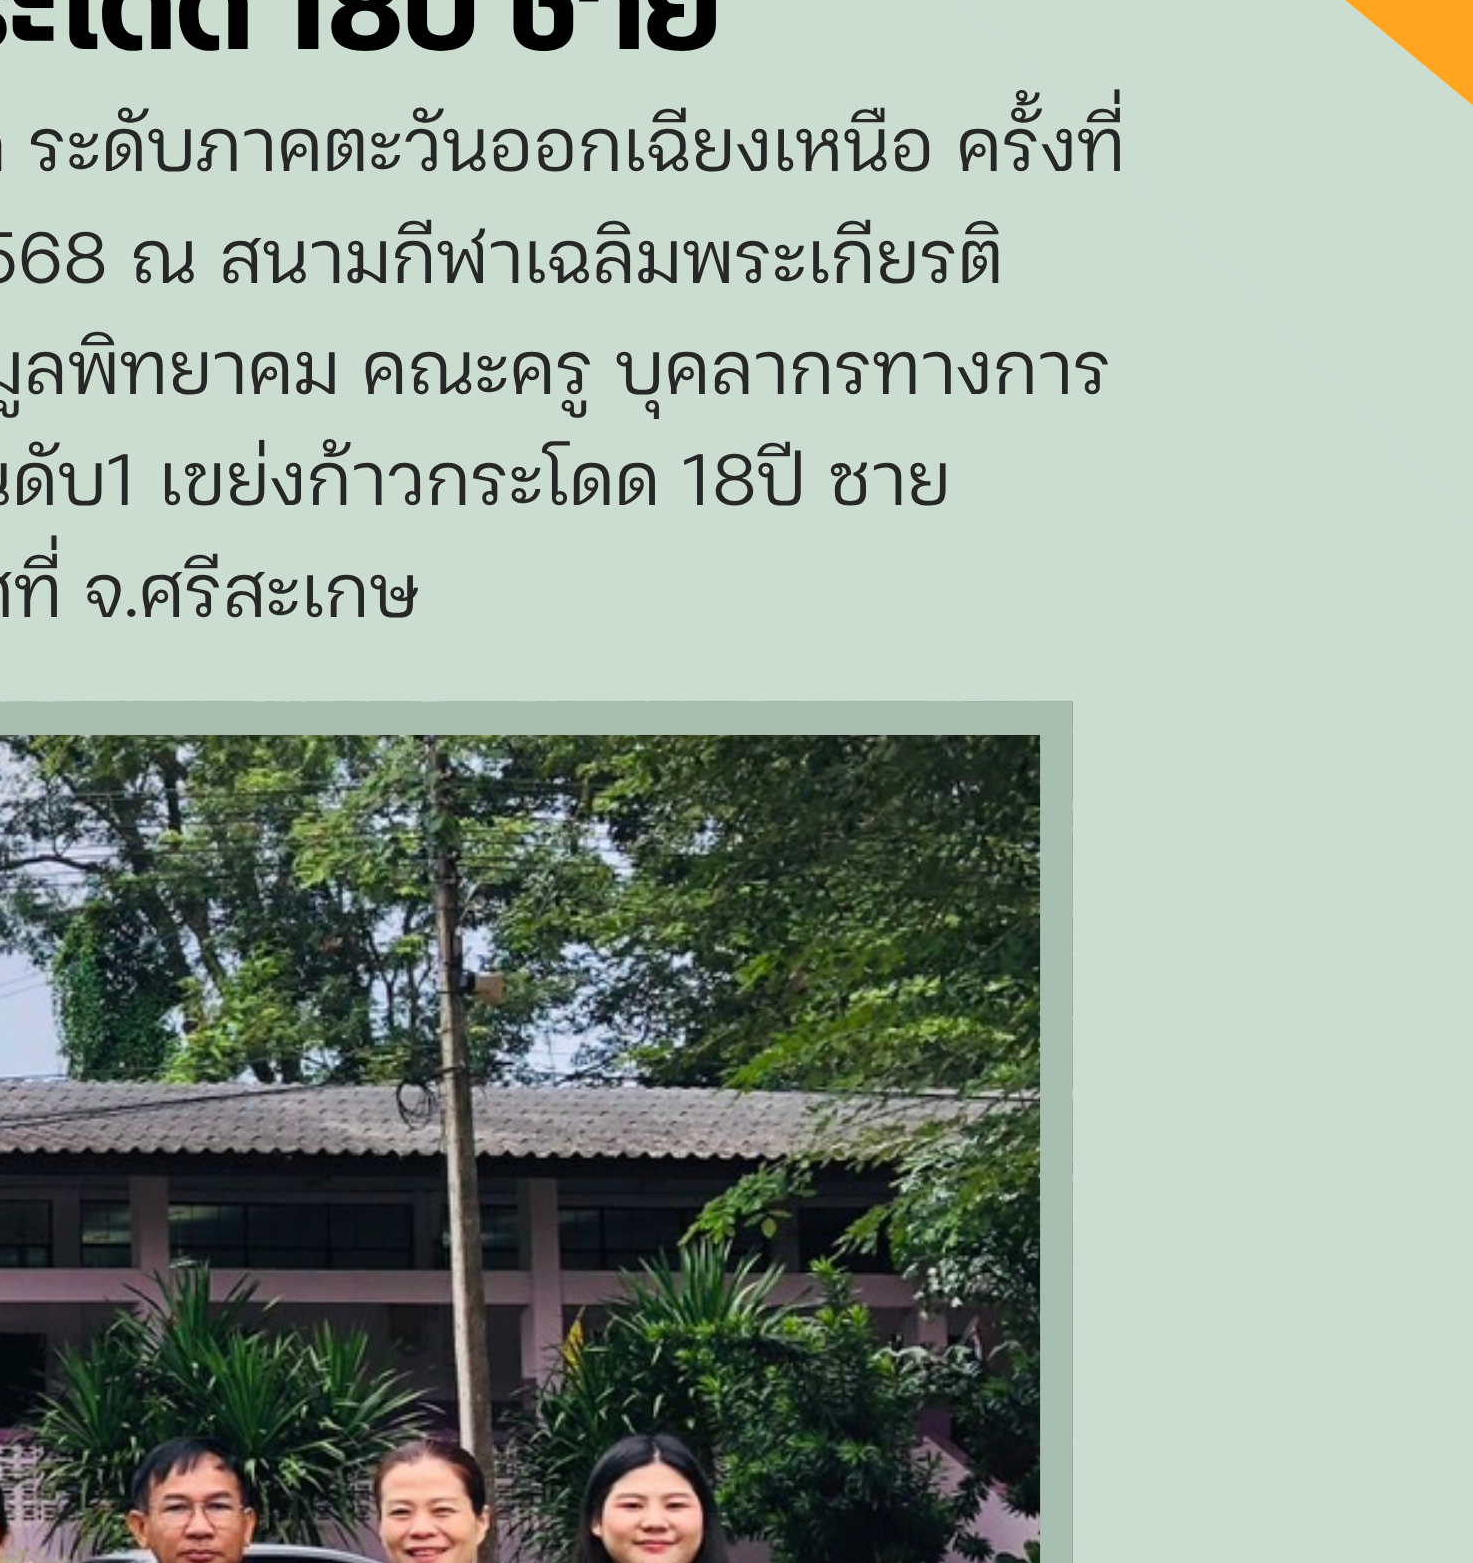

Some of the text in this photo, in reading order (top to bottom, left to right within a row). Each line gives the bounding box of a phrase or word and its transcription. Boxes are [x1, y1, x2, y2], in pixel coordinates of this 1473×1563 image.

[29, 106, 931, 173] ระดับภาคตะวันออกเฉียงเหนือ
[958, 88, 1122, 173] ครั้งที่
[132, 239, 196, 285] ณ
[221, 218, 1000, 285] สนามกีฬาเฉลิมพระเกียรติ
[364, 350, 592, 420] คณะครู
[615, 350, 1110, 421] บุคลากรทางการ
[163, 437, 657, 507] เขย่งก้าวกระโดด
[682, 440, 803, 507] 18ปี
[829, 461, 947, 507] ชาย
[85, 552, 420, 619] จ.ศรีสะเกษ
